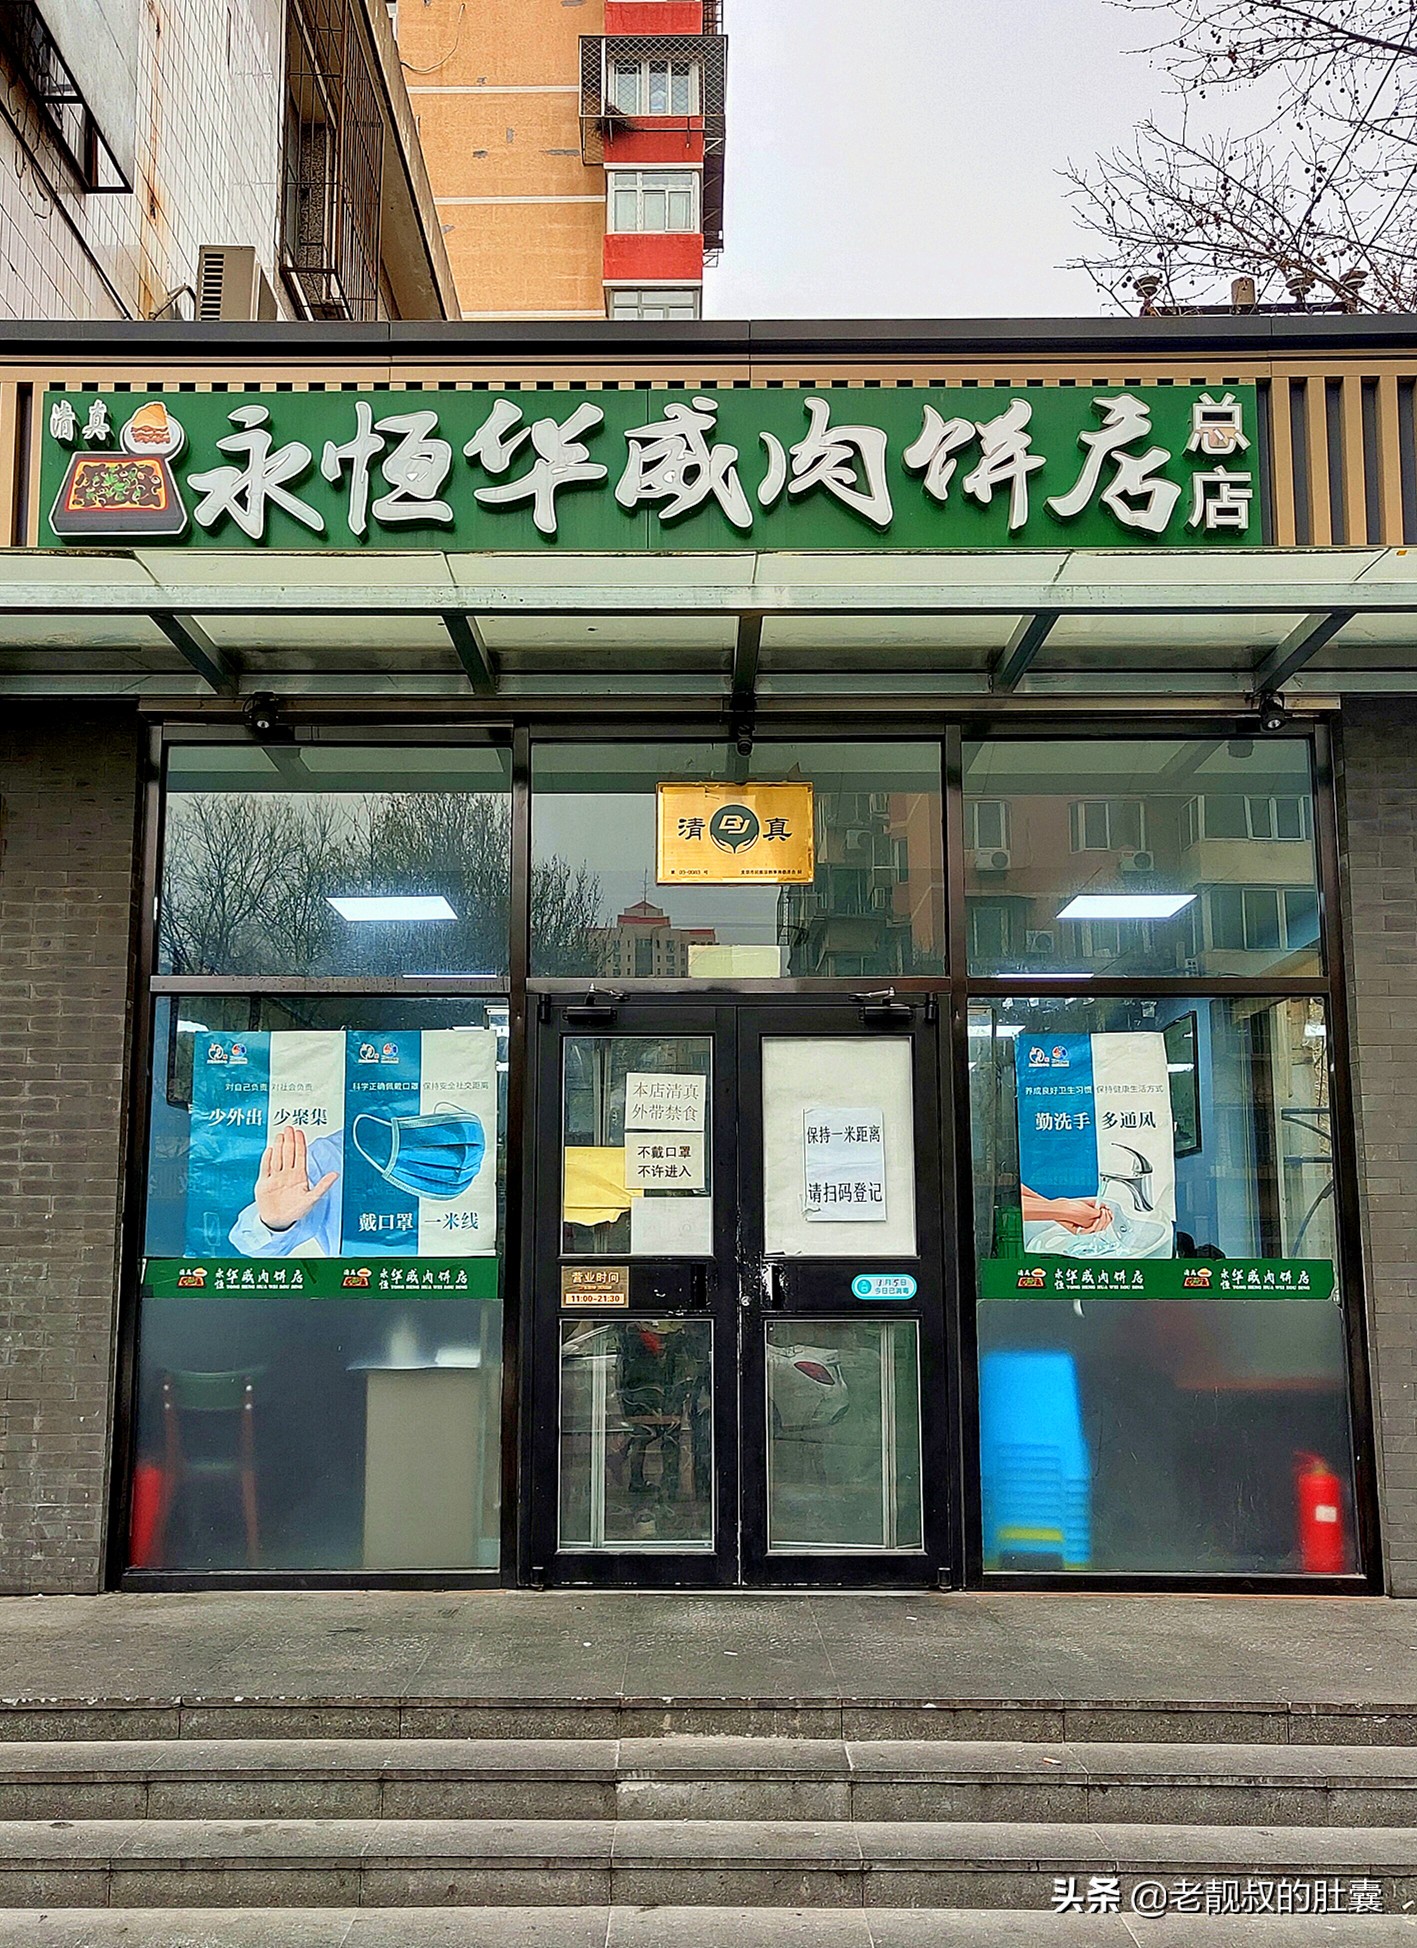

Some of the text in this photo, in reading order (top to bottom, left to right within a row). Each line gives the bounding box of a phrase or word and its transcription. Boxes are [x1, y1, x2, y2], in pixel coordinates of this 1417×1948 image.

[50, 399, 110, 441] 清真
[188, 392, 1184, 541] 永恒华威肉饼店
[1187, 392, 1252, 531] 总店
[677, 817, 793, 841] 清 真
[633, 1081, 699, 1100] 本店清真
[1025, 1084, 1165, 1096] 养成良好卫生习惯 保持健康生活方式
[208, 1108, 328, 1126] 少外出 少聚集
[632, 1103, 699, 1122] 外带禁食
[1034, 1110, 1157, 1131] 勤洗手 多通风
[806, 1125, 881, 1145] 保持一米距离
[637, 1145, 692, 1159] 不戴口罩
[637, 1165, 692, 1178] 不许进入
[808, 1181, 884, 1203] 请扫码登记
[358, 1212, 479, 1232] 戴口罩 一米线
[571, 1271, 619, 1284] 营业时间
[571, 1295, 620, 1303] 11:00-21:30
